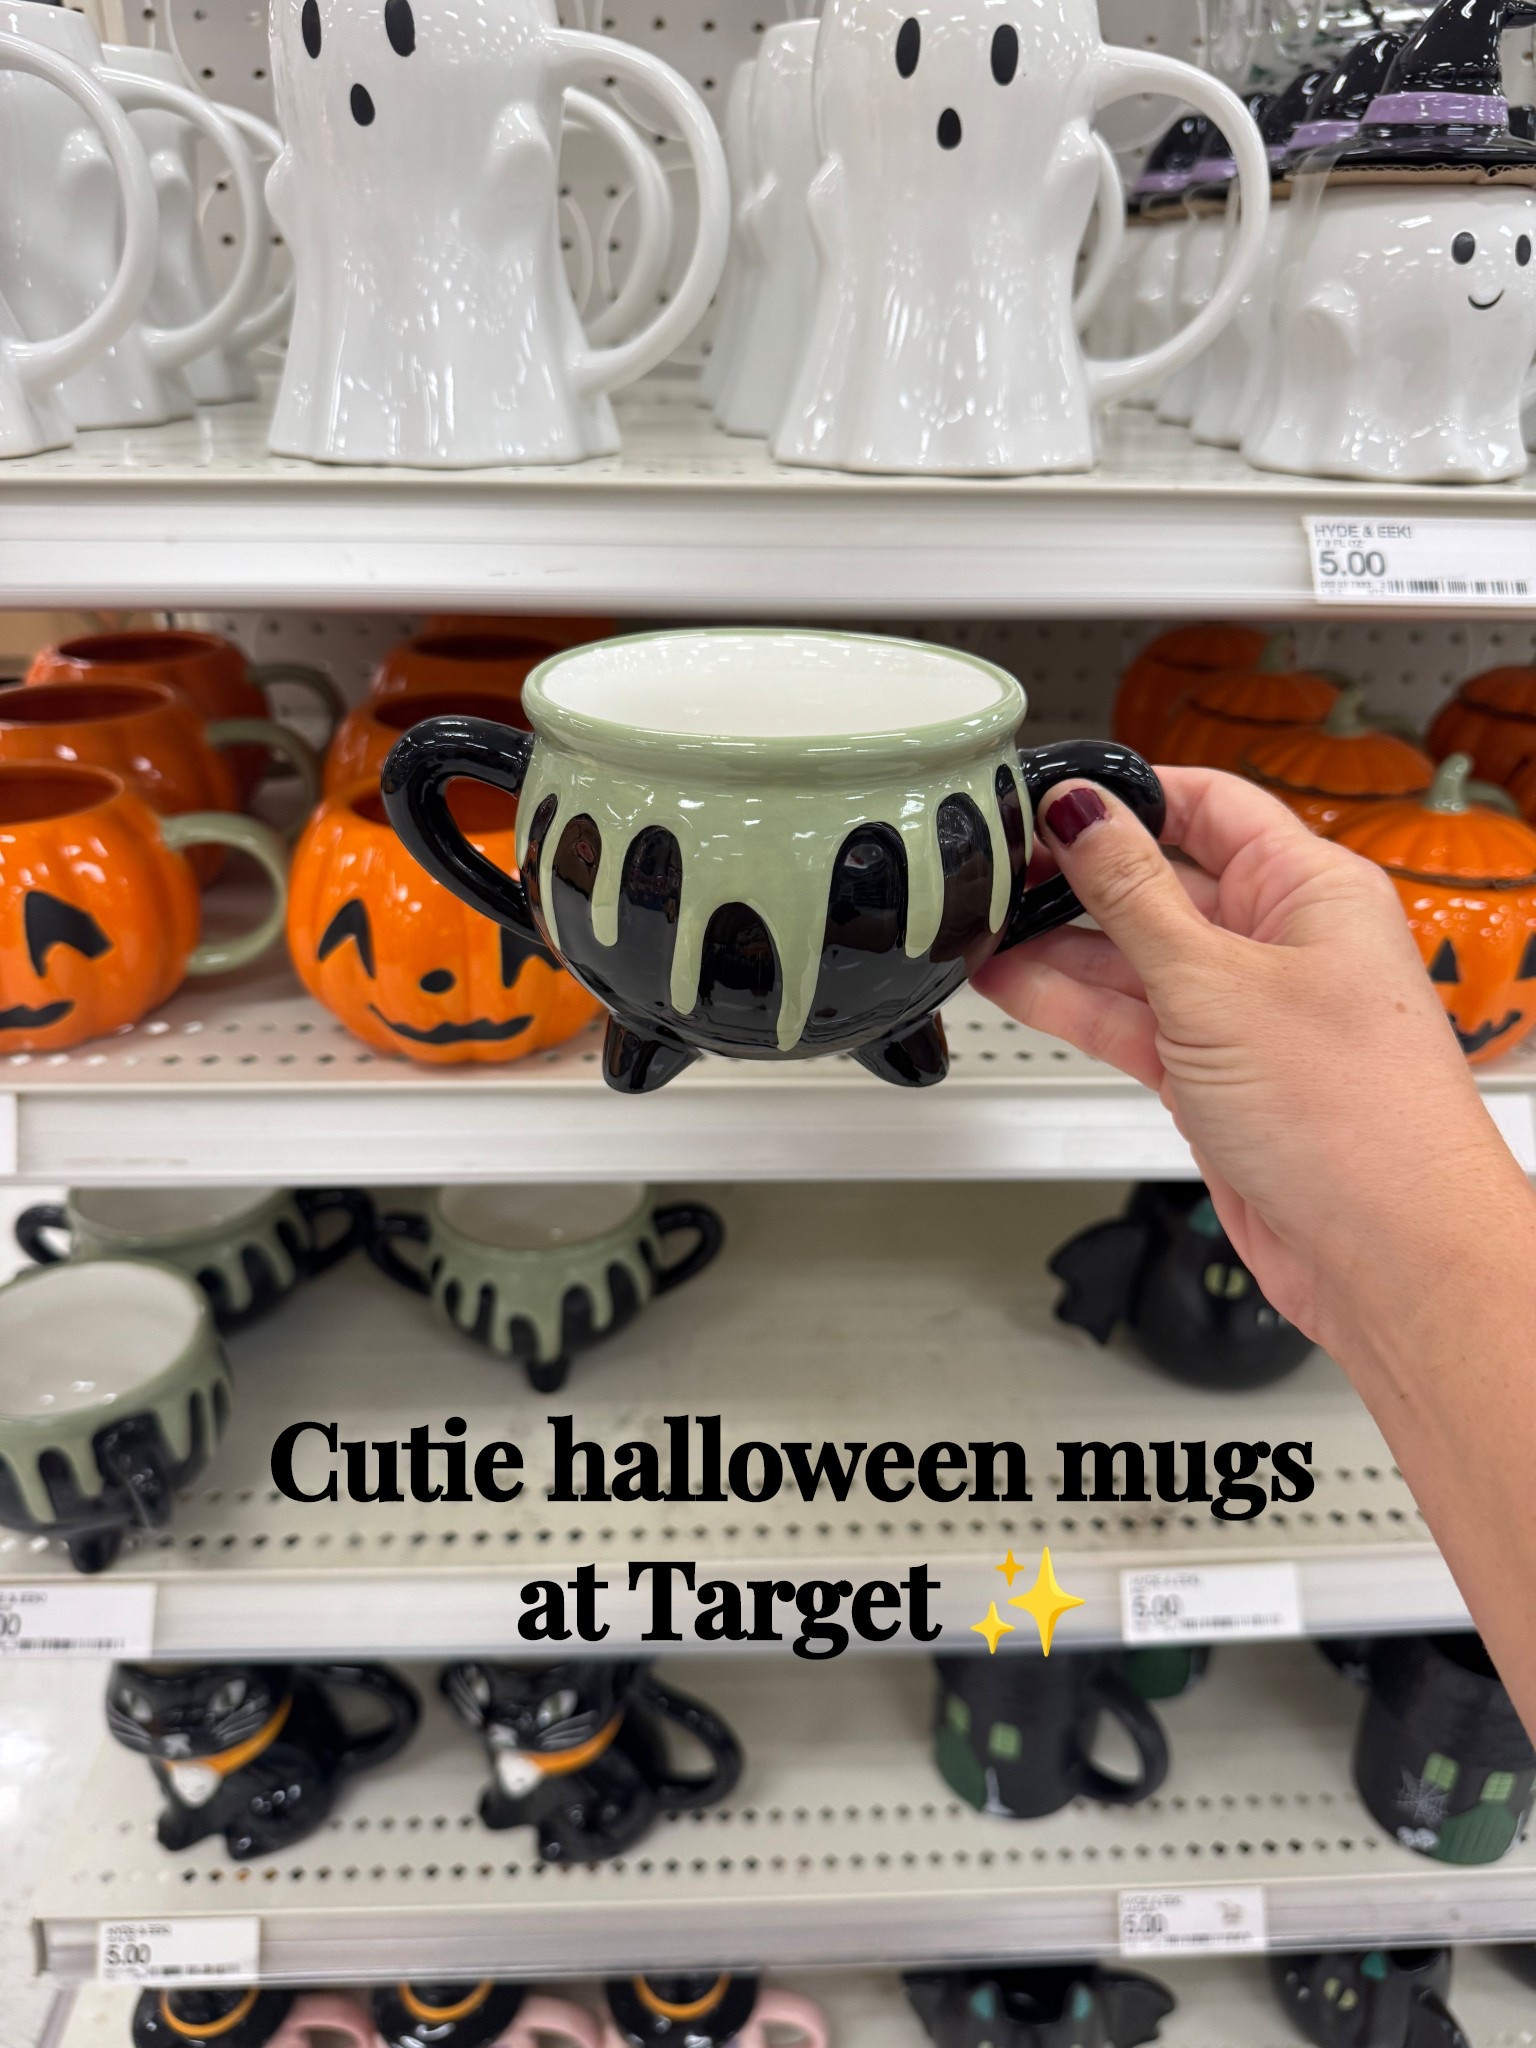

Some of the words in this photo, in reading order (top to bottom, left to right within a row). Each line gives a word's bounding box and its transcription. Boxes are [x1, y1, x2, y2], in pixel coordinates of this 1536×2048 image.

[1314, 524, 1359, 538] HYDE
[1362, 525, 1373, 538] &
[1377, 525, 1412, 539] EEK!
[1319, 551, 1386, 577] 5.00
[106, 1943, 151, 1965] 5.00
